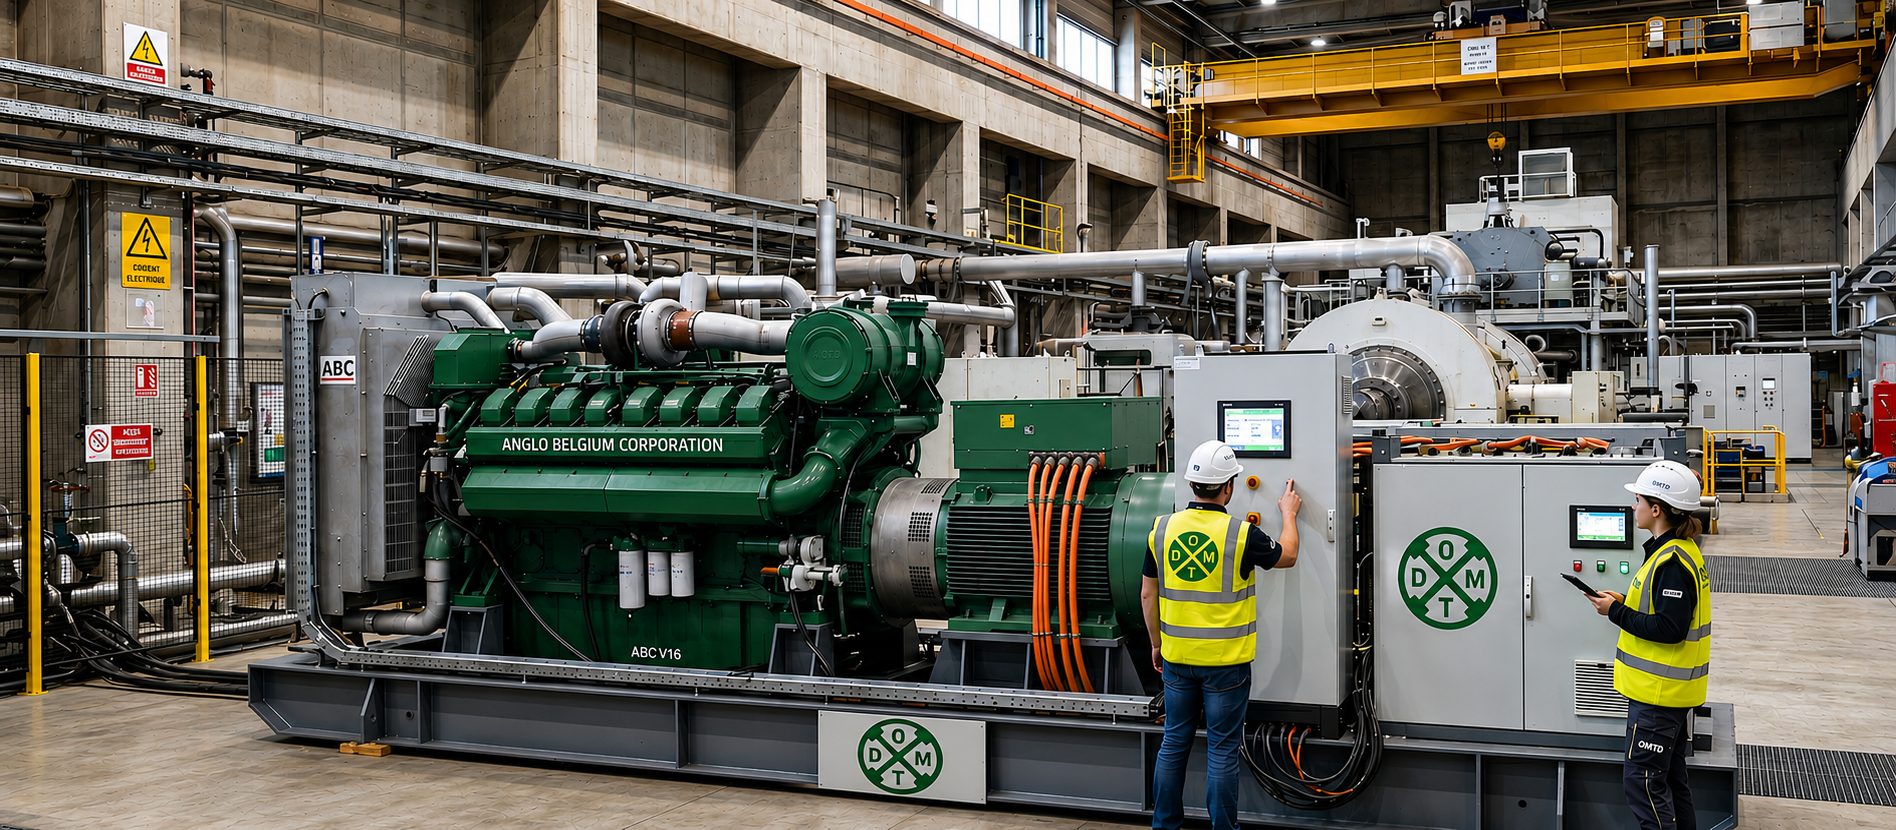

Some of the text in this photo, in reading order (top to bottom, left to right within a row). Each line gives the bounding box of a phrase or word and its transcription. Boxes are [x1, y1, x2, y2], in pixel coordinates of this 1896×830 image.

[322, 360, 354, 377] ABC
[502, 437, 723, 452] ANGLO BELGIUM CORPORATION
[631, 646, 681, 660] ABC V16
[1638, 740, 1664, 753] OMTD
